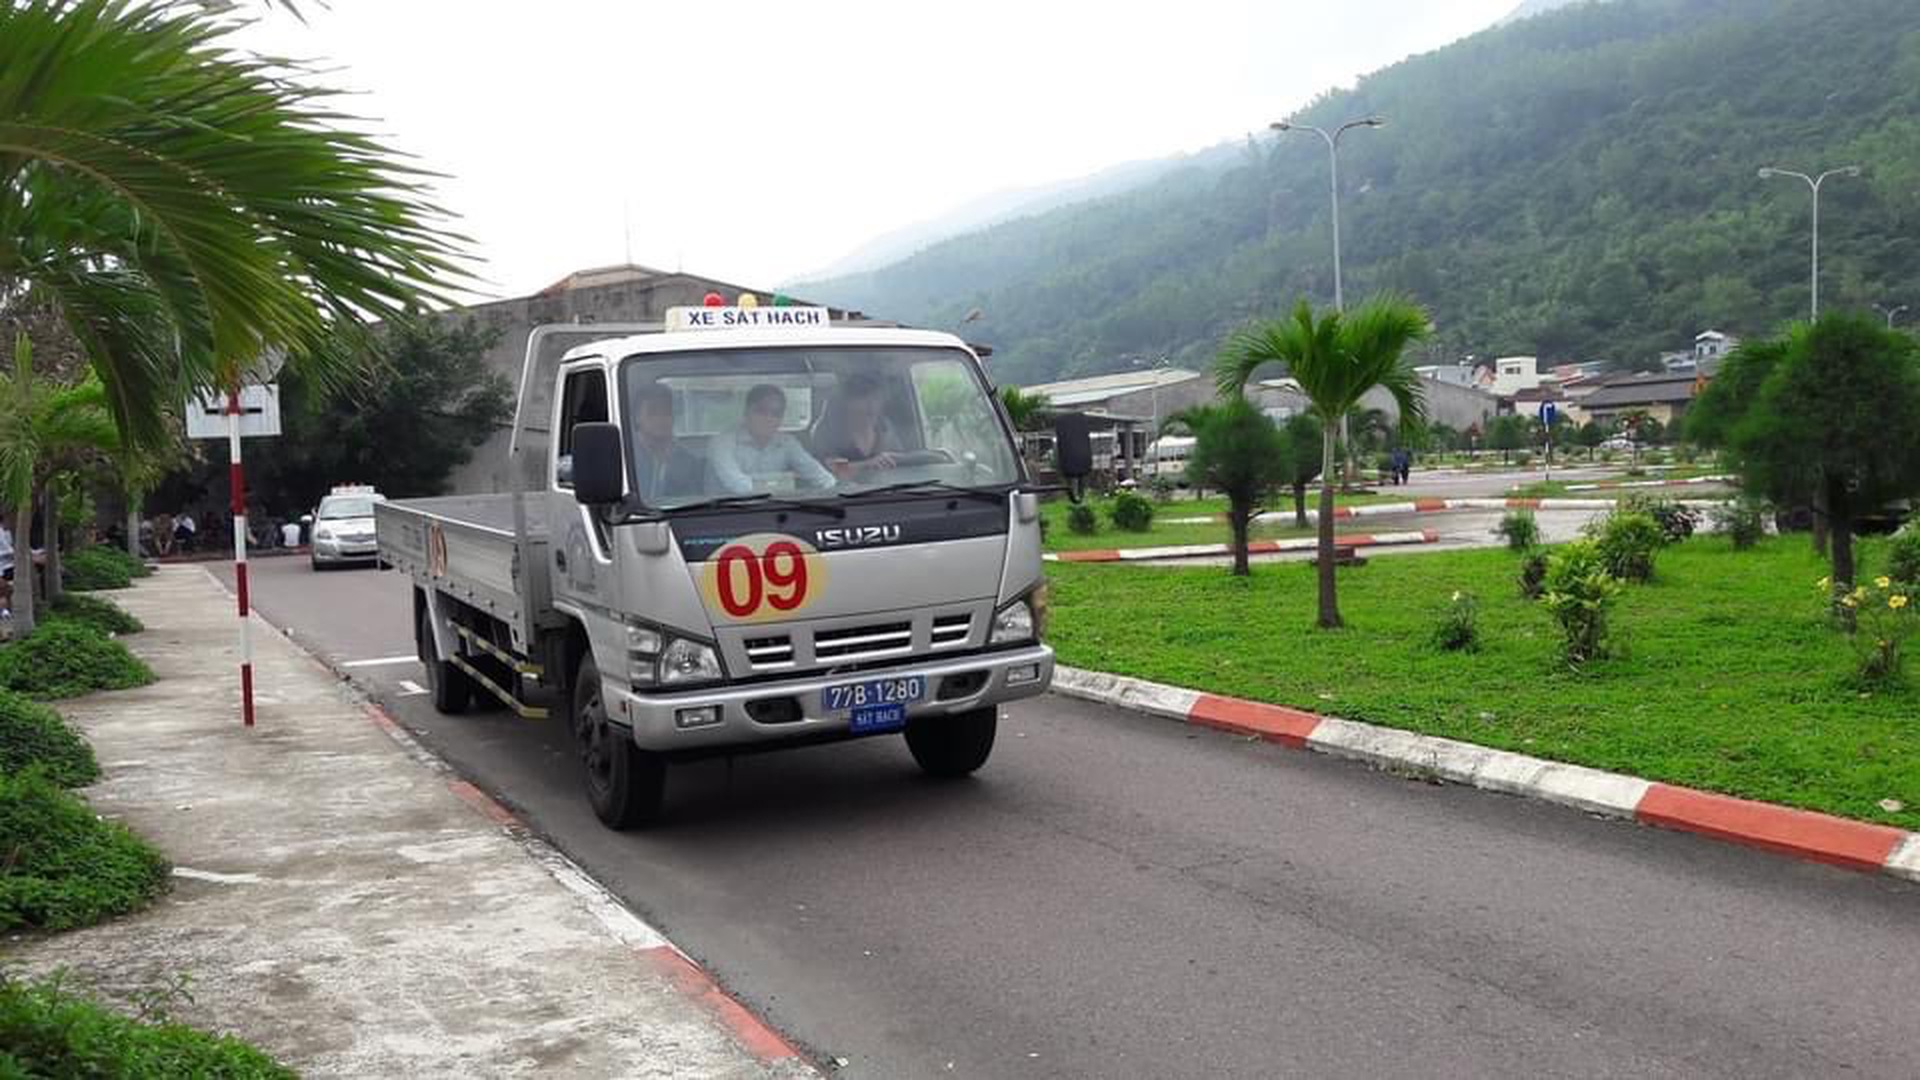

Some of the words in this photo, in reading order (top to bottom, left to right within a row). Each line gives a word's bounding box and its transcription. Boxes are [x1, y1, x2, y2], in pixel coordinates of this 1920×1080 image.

[688, 311, 714, 326] XE
[815, 523, 901, 546] ISUZU
[716, 541, 809, 617] 09
